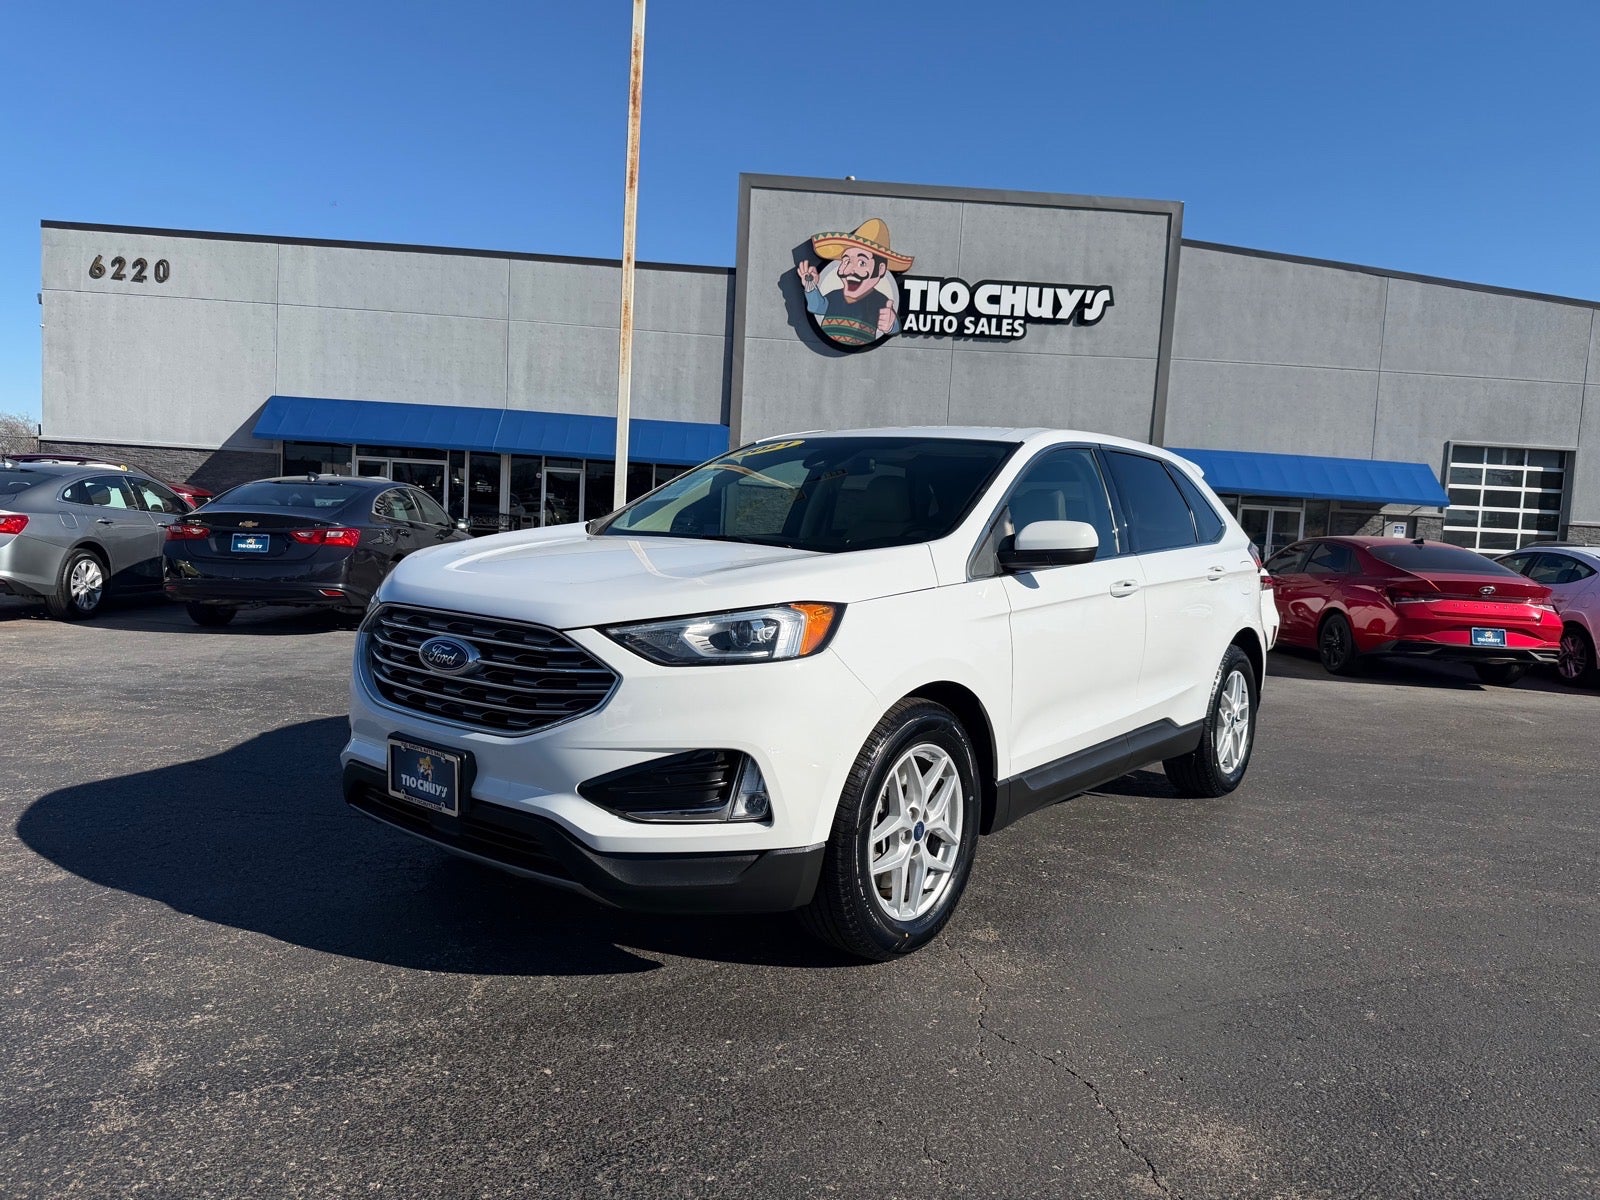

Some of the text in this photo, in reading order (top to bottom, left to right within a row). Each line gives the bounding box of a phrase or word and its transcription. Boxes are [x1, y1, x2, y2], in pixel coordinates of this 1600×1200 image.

[89, 254, 170, 283] 6220
[904, 279, 1111, 321] TIO CHUY'S
[903, 313, 1025, 337] AUTO SALES
[427, 643, 458, 666] Ford
[401, 773, 448, 798] TIO CHUY'S
